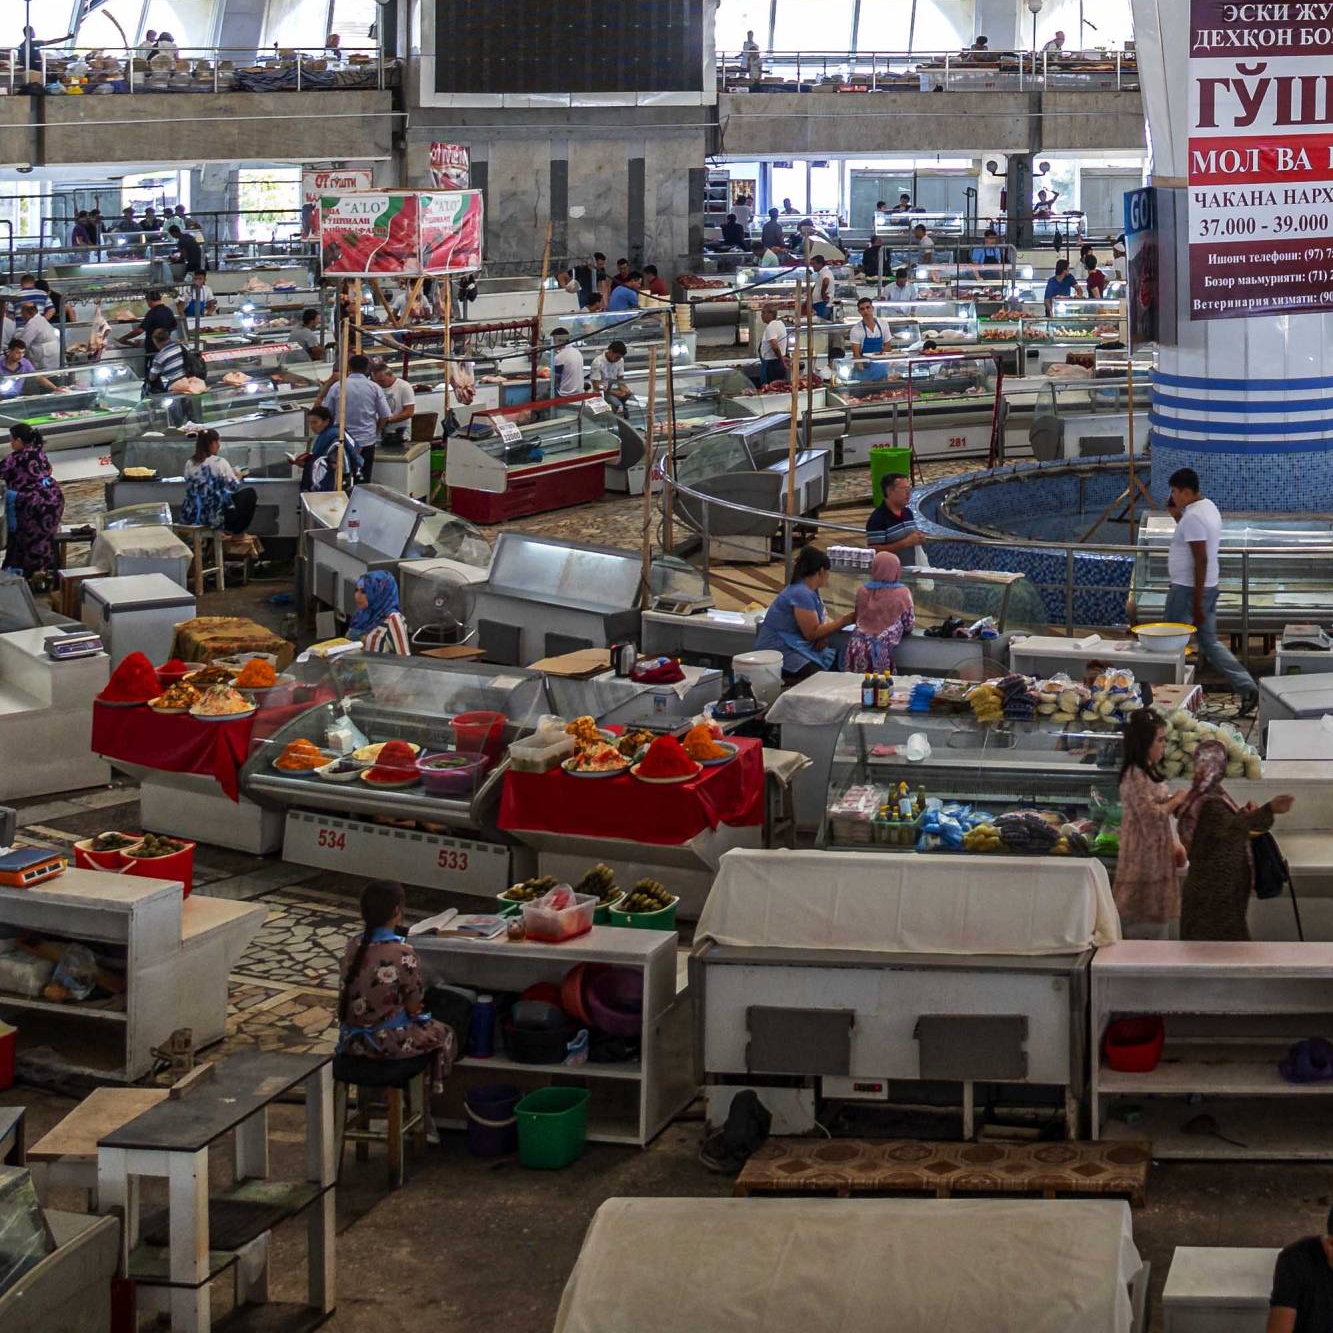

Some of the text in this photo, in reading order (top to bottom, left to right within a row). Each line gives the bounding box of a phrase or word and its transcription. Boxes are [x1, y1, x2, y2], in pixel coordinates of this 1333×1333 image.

[1223, 4, 1289, 22] ЭСКИ
[1193, 28, 1293, 51] ДЕХҚОН
[1192, 149, 1261, 174] МОЛ
[1276, 147, 1312, 171] ВА
[315, 174, 329, 188] ОТ
[1194, 190, 1278, 208] ЧАКАНА
[1200, 218, 1256, 236] 37.000
[1273, 214, 1328, 233] 39.000
[1208, 253, 1246, 265] Ишонч
[1249, 250, 1302, 266] телефони:
[1304, 247, 1323, 261] (97)
[1204, 276, 1235, 288] Бозор
[1308, 269, 1327, 283] (71)
[1193, 297, 1270, 311] Ветеринария
[1271, 294, 1317, 306] хизмати:
[950, 438, 965, 447] 281
[318, 829, 346, 851] 534
[438, 850, 468, 871] 533
